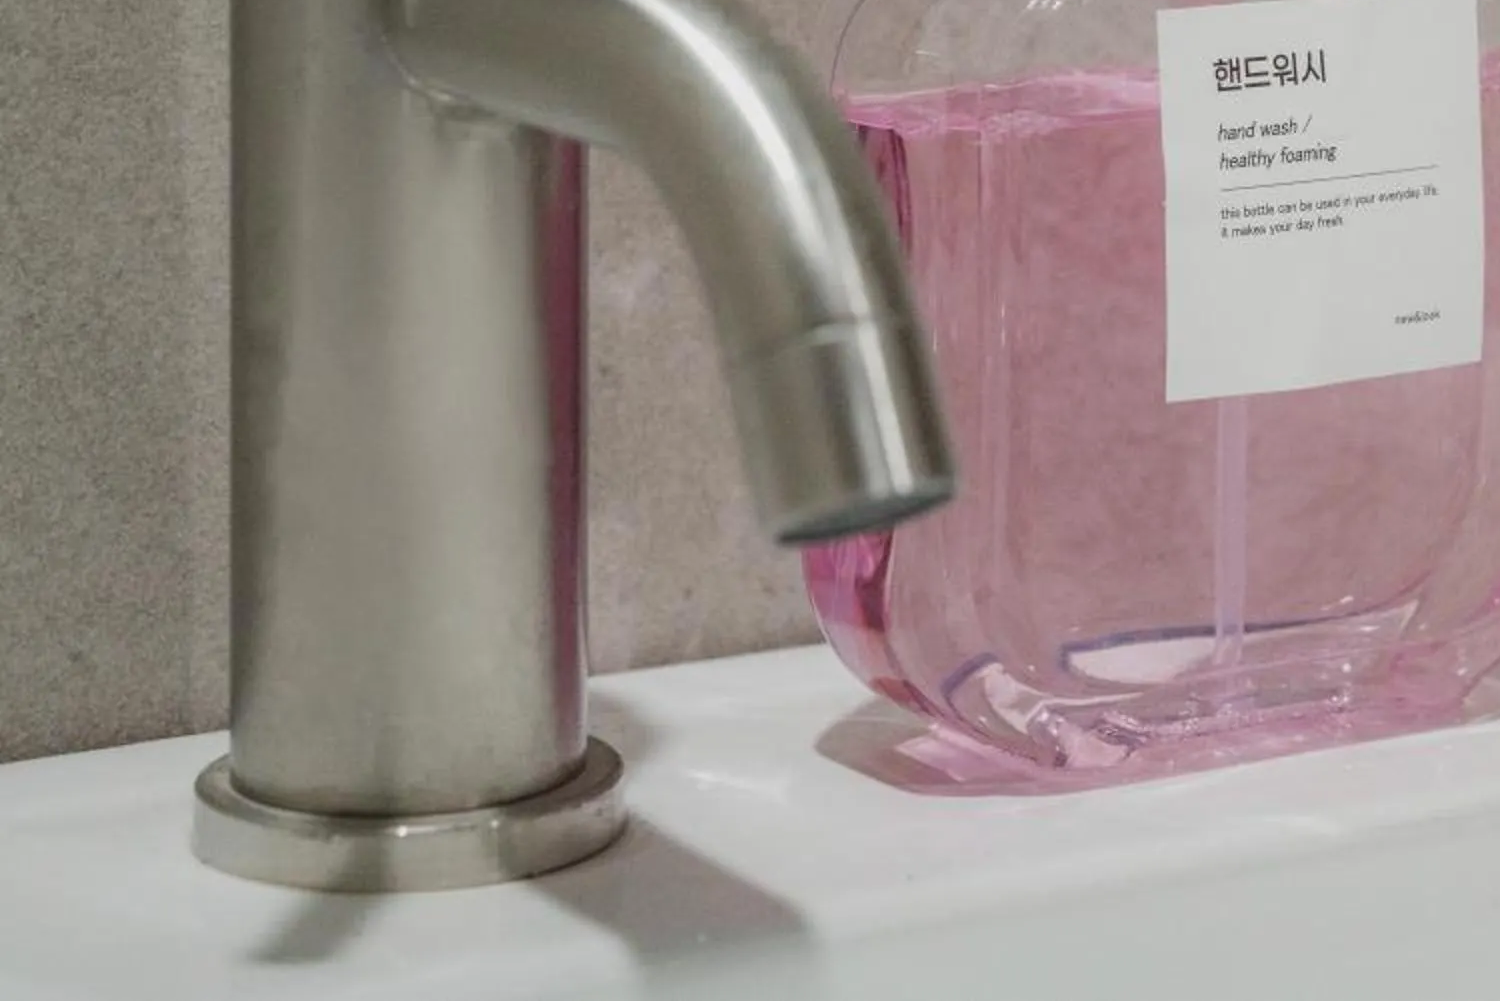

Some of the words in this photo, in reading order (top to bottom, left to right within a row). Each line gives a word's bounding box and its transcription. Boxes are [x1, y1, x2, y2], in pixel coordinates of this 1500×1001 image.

[1213, 49, 1327, 91] 핸드워시
[1218, 120, 1257, 141] hand
[1260, 118, 1298, 137] wash
[1302, 114, 1313, 133] /
[1219, 149, 1276, 170] healthy
[1280, 142, 1337, 163] foaming
[1221, 206, 1240, 219] this
[1243, 203, 1274, 217] bottle
[1279, 203, 1297, 214] can
[1299, 199, 1313, 212] be
[1315, 198, 1341, 210] used
[1355, 194, 1375, 207] your
[1379, 187, 1420, 202] everyday
[1231, 224, 1266, 238] makes
[1269, 222, 1293, 236] your
[1296, 218, 1314, 232] day
[1317, 215, 1343, 228] fresh
